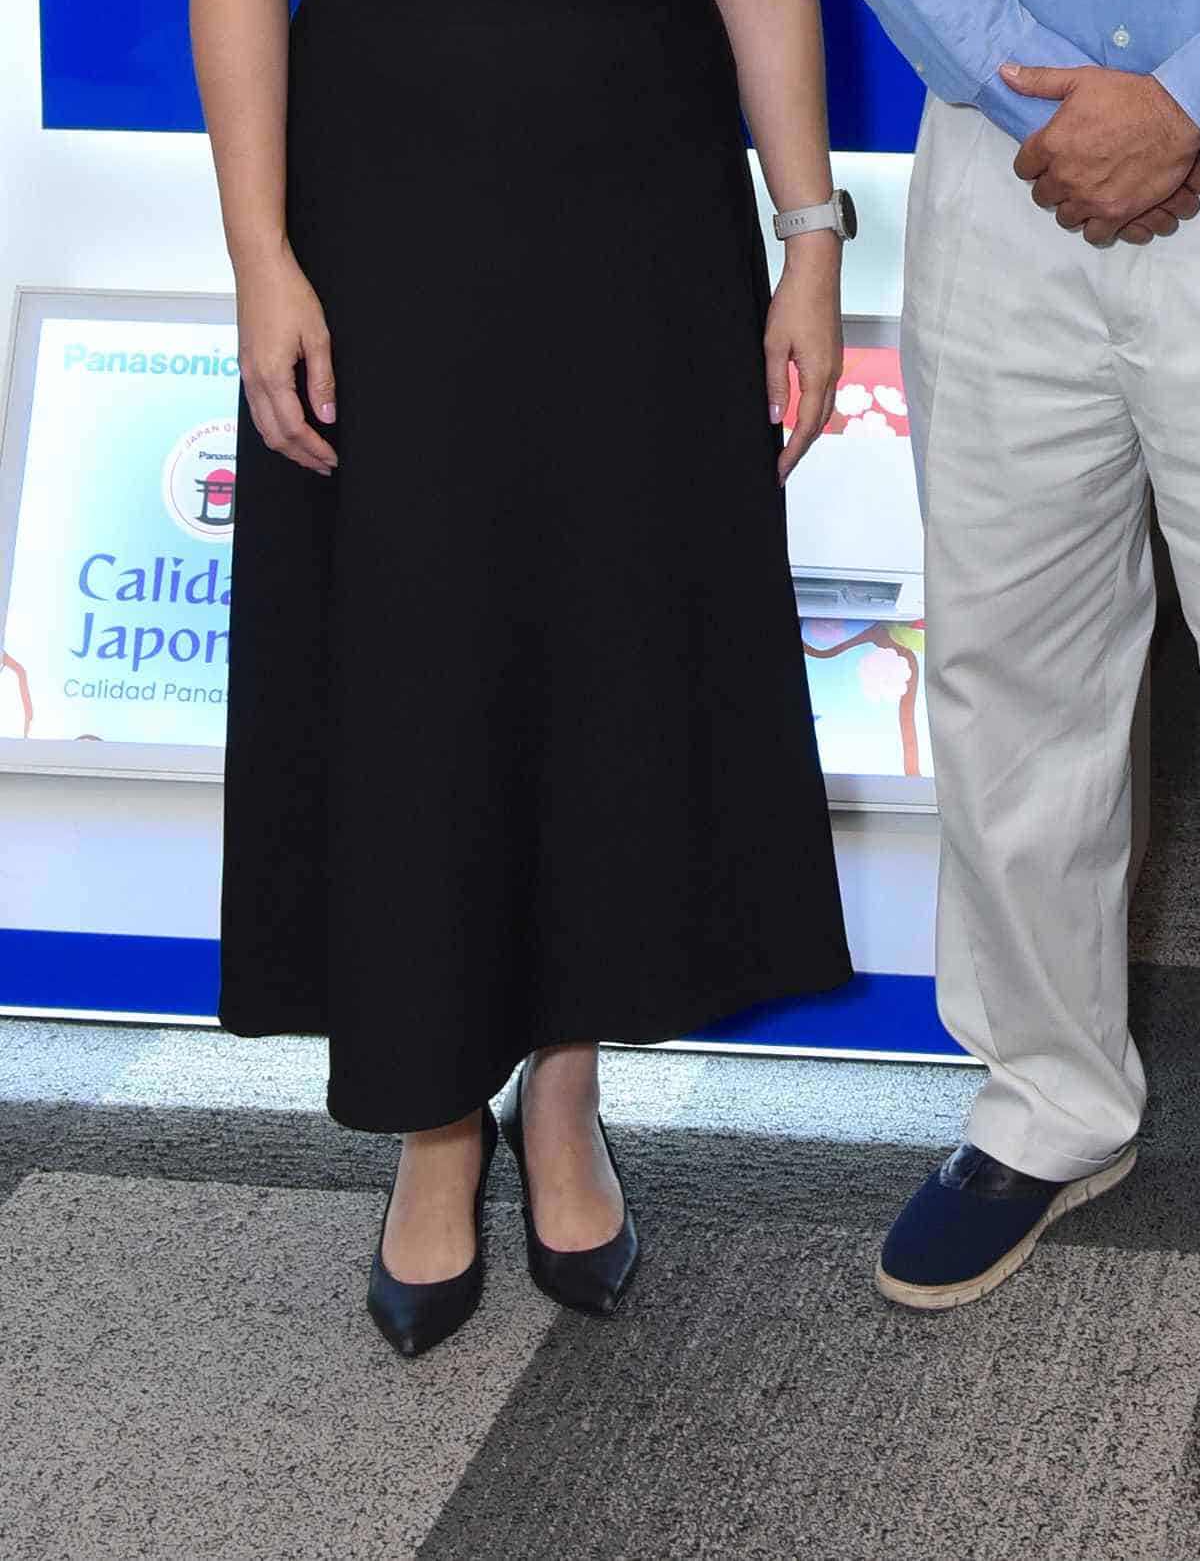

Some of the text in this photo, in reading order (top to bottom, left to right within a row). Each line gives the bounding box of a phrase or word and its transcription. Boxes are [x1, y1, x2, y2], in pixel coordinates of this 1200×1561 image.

[63, 342, 240, 376] Panasonic
[186, 424, 220, 448] JAPAN
[63, 678, 229, 703] Calidad Pana
